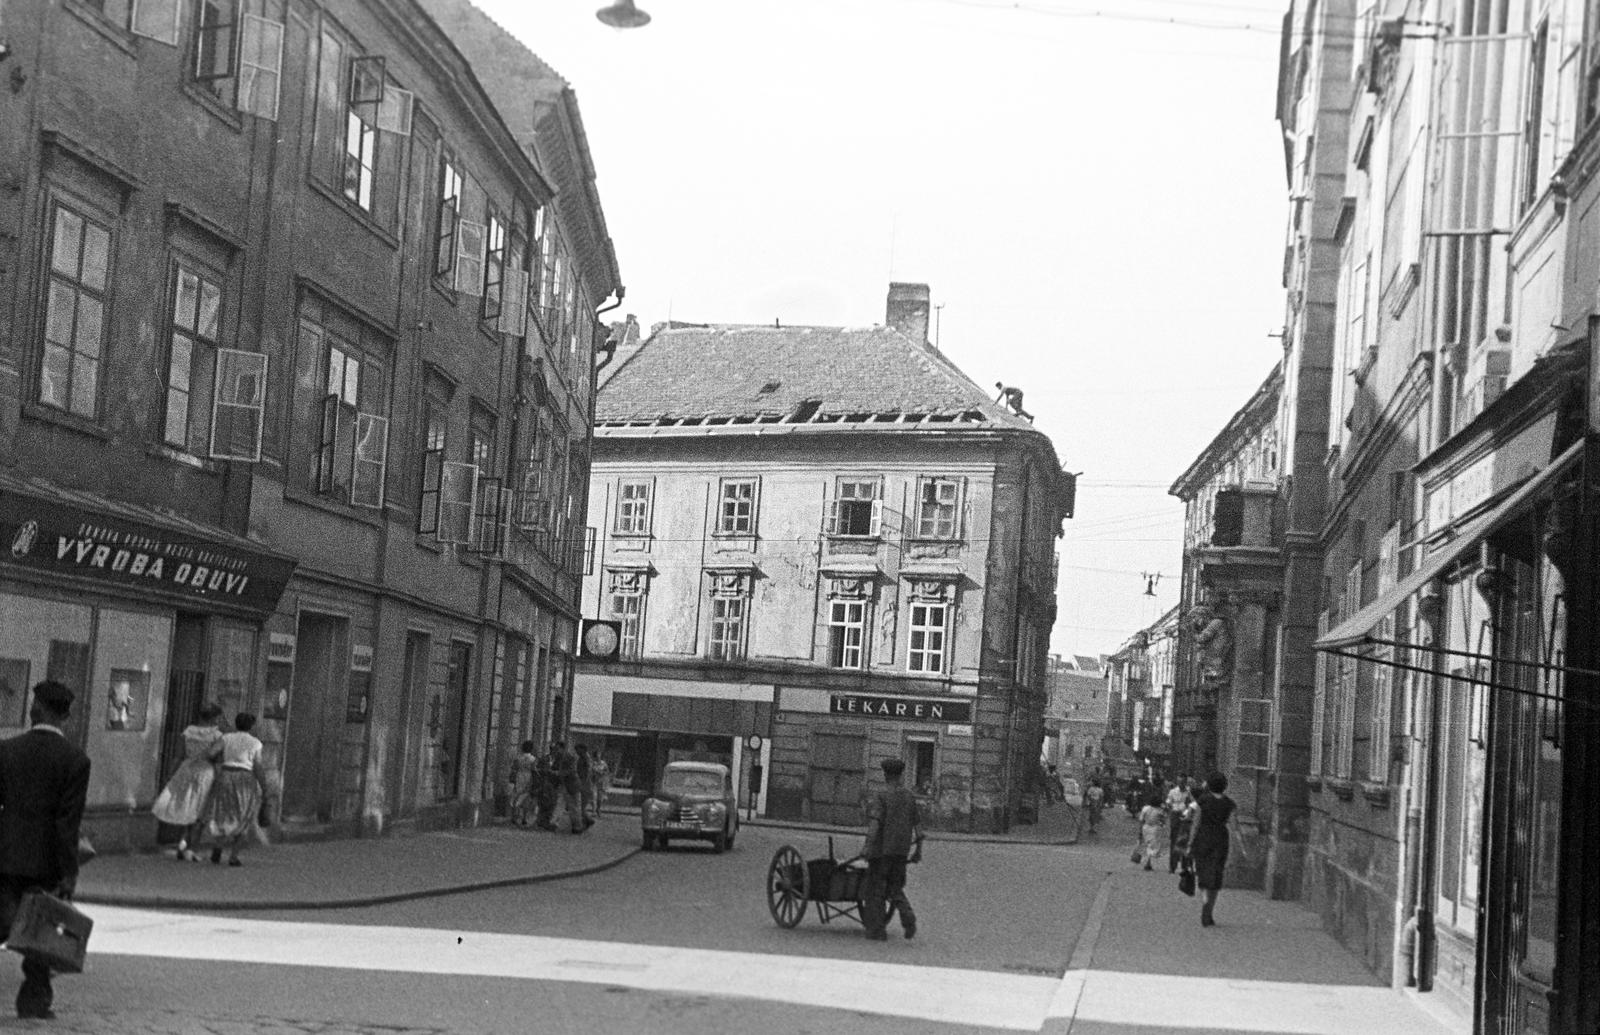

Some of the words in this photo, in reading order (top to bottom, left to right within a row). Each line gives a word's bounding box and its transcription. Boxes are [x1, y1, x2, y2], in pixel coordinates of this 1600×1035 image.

[57, 536, 164, 578] VÝROBA
[174, 563, 249, 595] OBUVI
[836, 698, 943, 718] LEKÁREŇ
